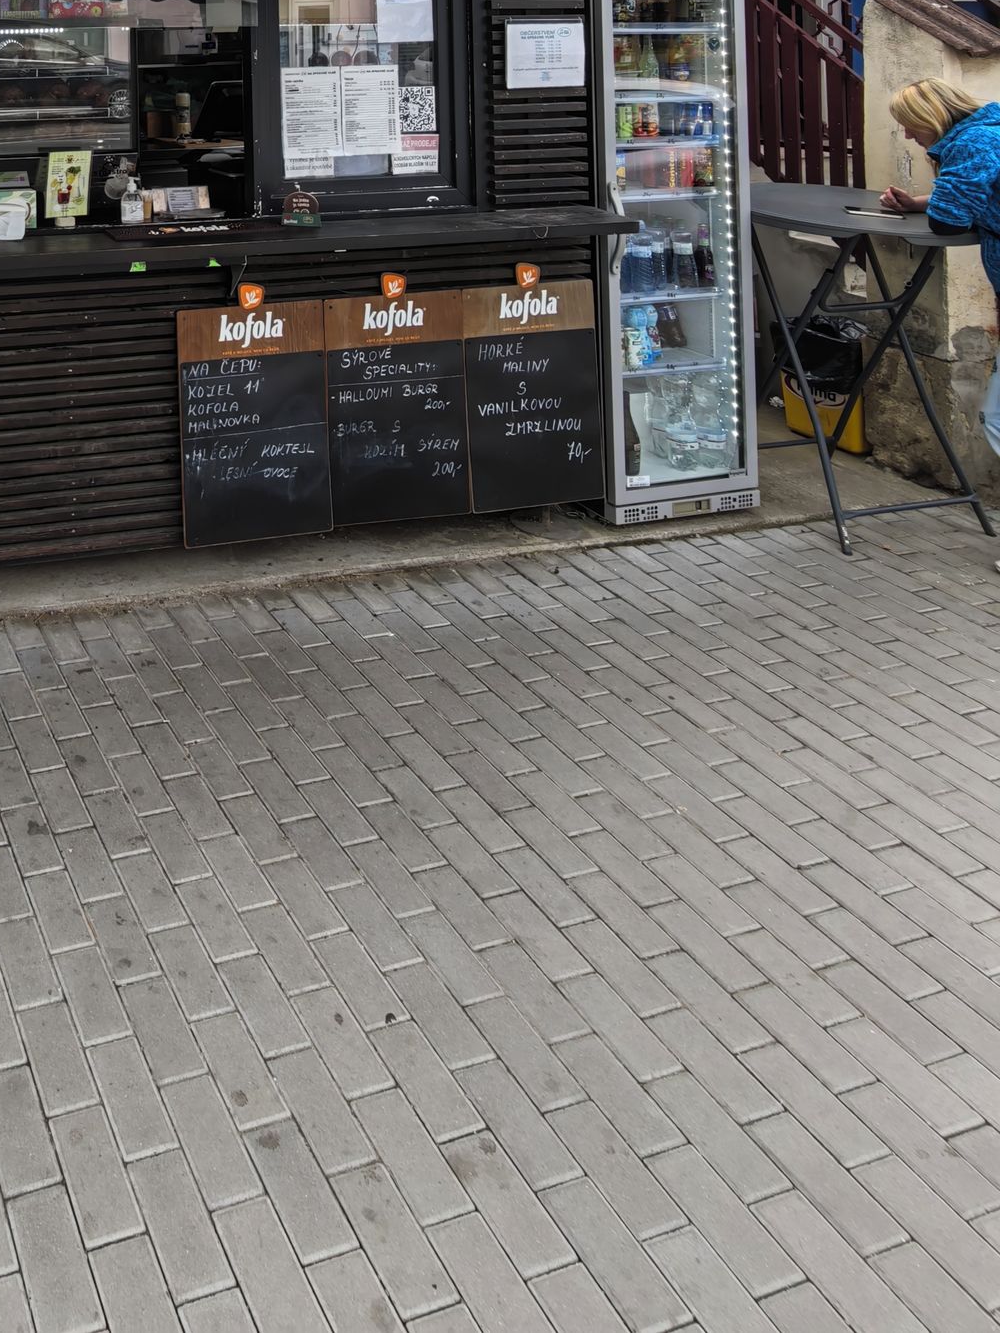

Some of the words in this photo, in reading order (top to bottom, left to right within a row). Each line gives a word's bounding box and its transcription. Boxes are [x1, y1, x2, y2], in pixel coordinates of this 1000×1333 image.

[411, 139, 437, 147] PRODEJE
[180, 224, 230, 234] kofola
[500, 289, 557, 324] kofola
[363, 300, 424, 336] kofola
[218, 311, 283, 348] kofola
[341, 346, 392, 368] SÝROVÉ
[478, 336, 524, 361] HORKÉ
[188, 363, 209, 378] NA
[220, 356, 261, 375] ČEPU:
[363, 362, 437, 380] SPECIALITY:
[502, 358, 550, 373] MALINY
[188, 383, 234, 400] KOZEL
[339, 387, 393, 404] HALLOUMI
[402, 384, 438, 397] BURGR
[516, 381, 527, 396] S
[188, 401, 239, 416] KOFOLA
[478, 397, 562, 417] VANILKOVOU
[188, 414, 260, 434] MALINOVKA
[392, 420, 401, 433] S
[505, 418, 581, 436] ZMRZLINOU
[418, 433, 460, 452] SÝREM
[264, 466, 299, 479] OVOCE
